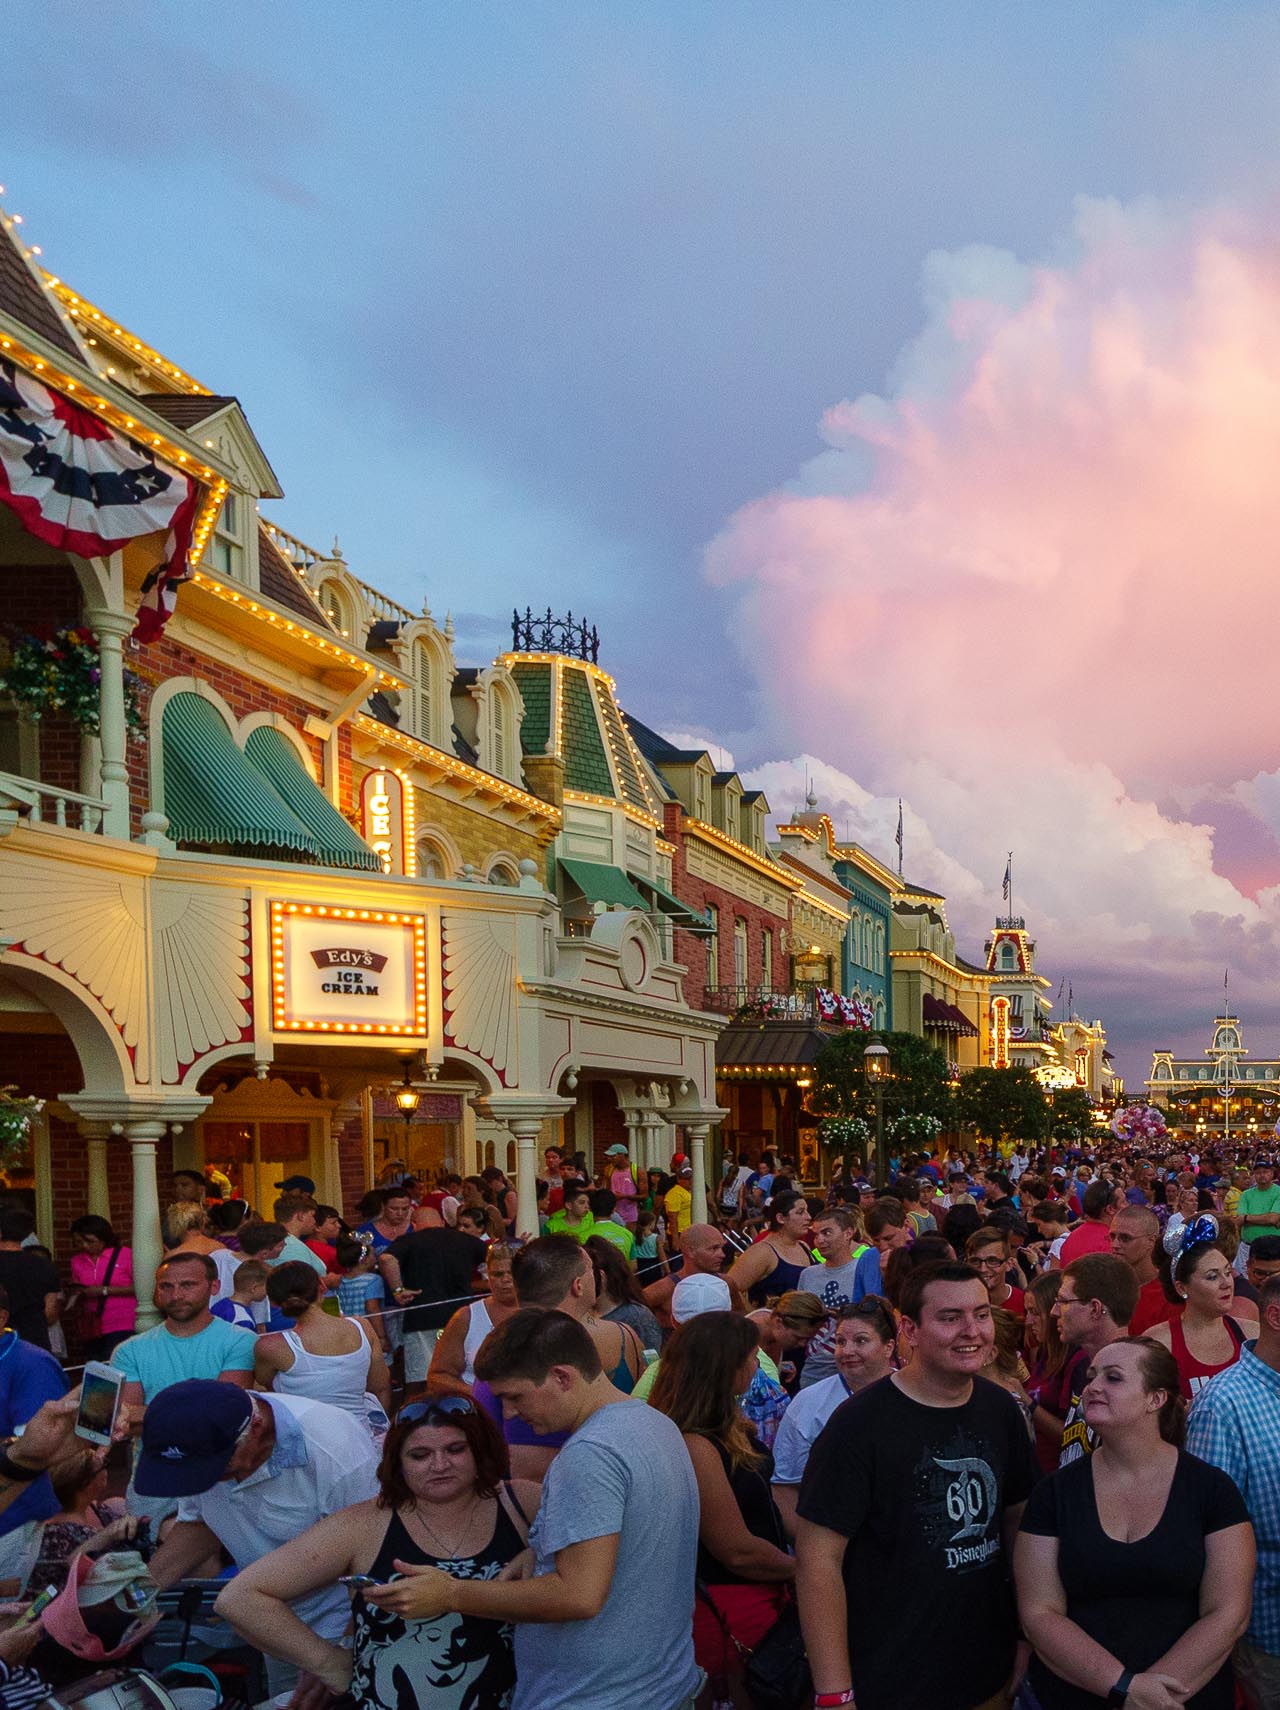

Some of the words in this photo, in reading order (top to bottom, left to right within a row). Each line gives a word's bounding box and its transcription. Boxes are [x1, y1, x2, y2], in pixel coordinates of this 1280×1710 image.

[369, 775, 390, 835] ICE
[326, 950, 374, 966] Edy's
[337, 971, 363, 983] ICE
[321, 983, 379, 996] CREAM
[946, 1478, 983, 1521] 60
